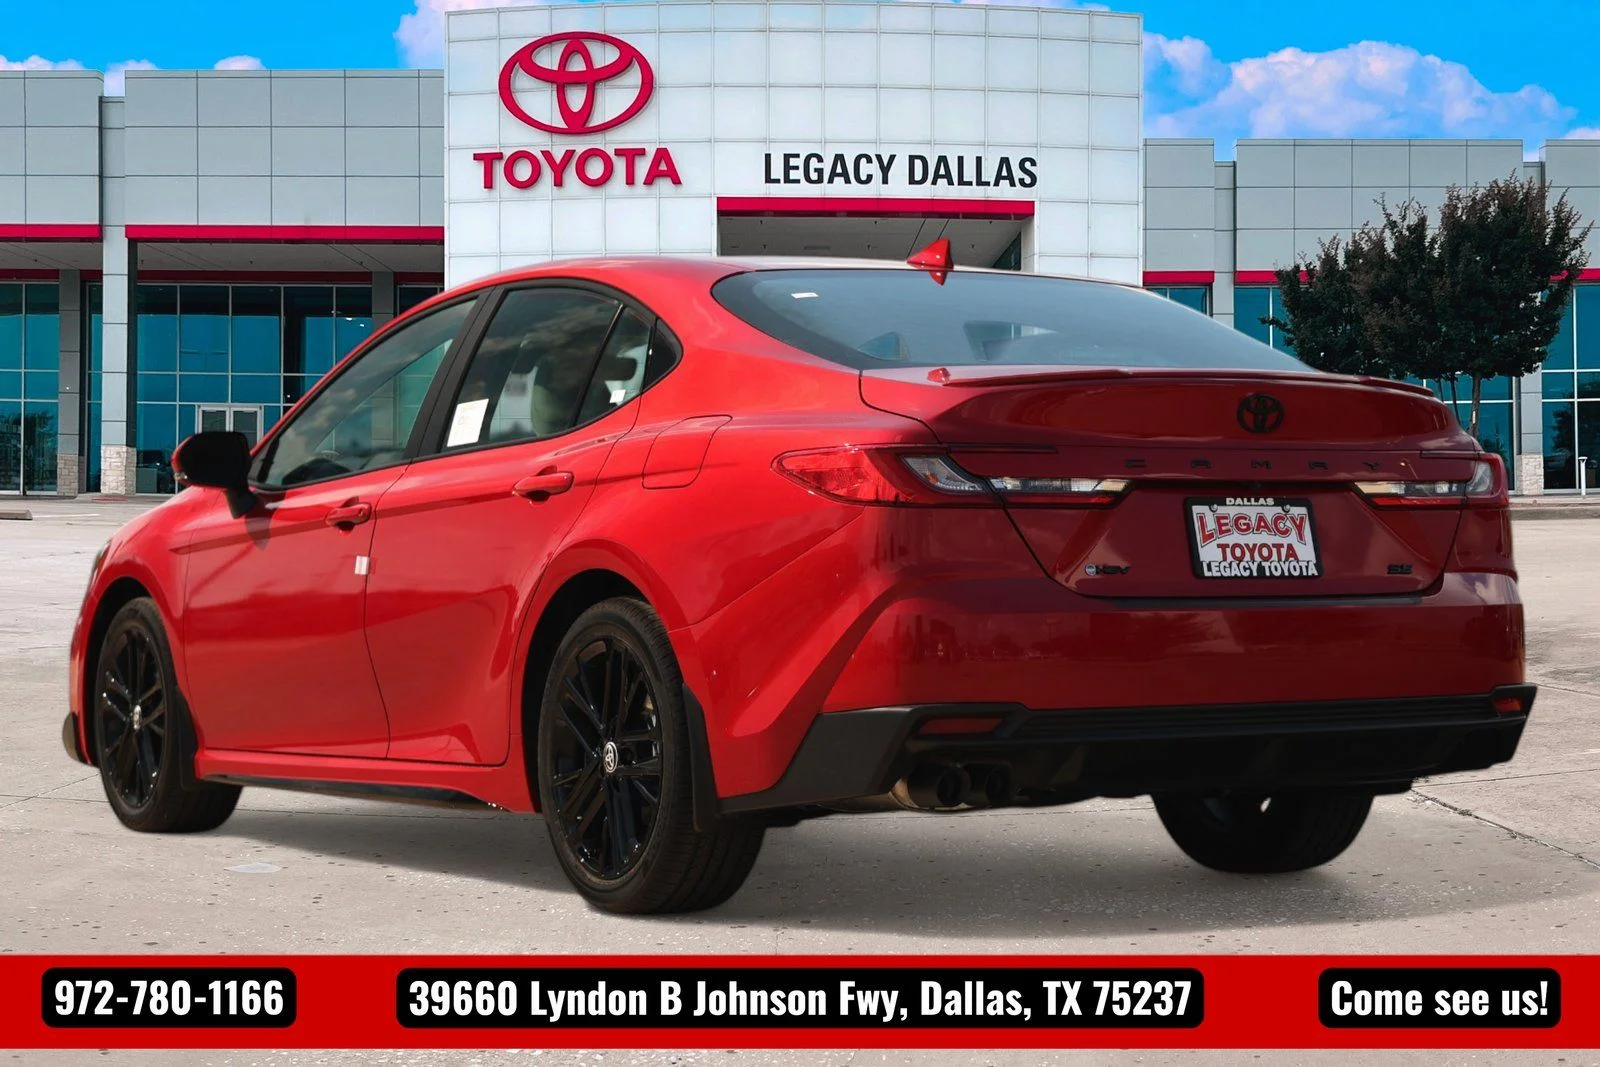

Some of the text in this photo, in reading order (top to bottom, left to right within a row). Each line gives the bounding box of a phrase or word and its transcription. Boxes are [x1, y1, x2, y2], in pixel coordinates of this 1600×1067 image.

[473, 147, 681, 189] TOYOTA
[764, 153, 1038, 188] LEGACY DALLAS
[1124, 458, 1381, 471] CAMRY
[1226, 497, 1275, 506] DALLAS
[1197, 513, 1307, 548] LEGACY
[1217, 543, 1299, 561] TOYOTA
[1203, 561, 1318, 577] LEGACY TOYOTA
